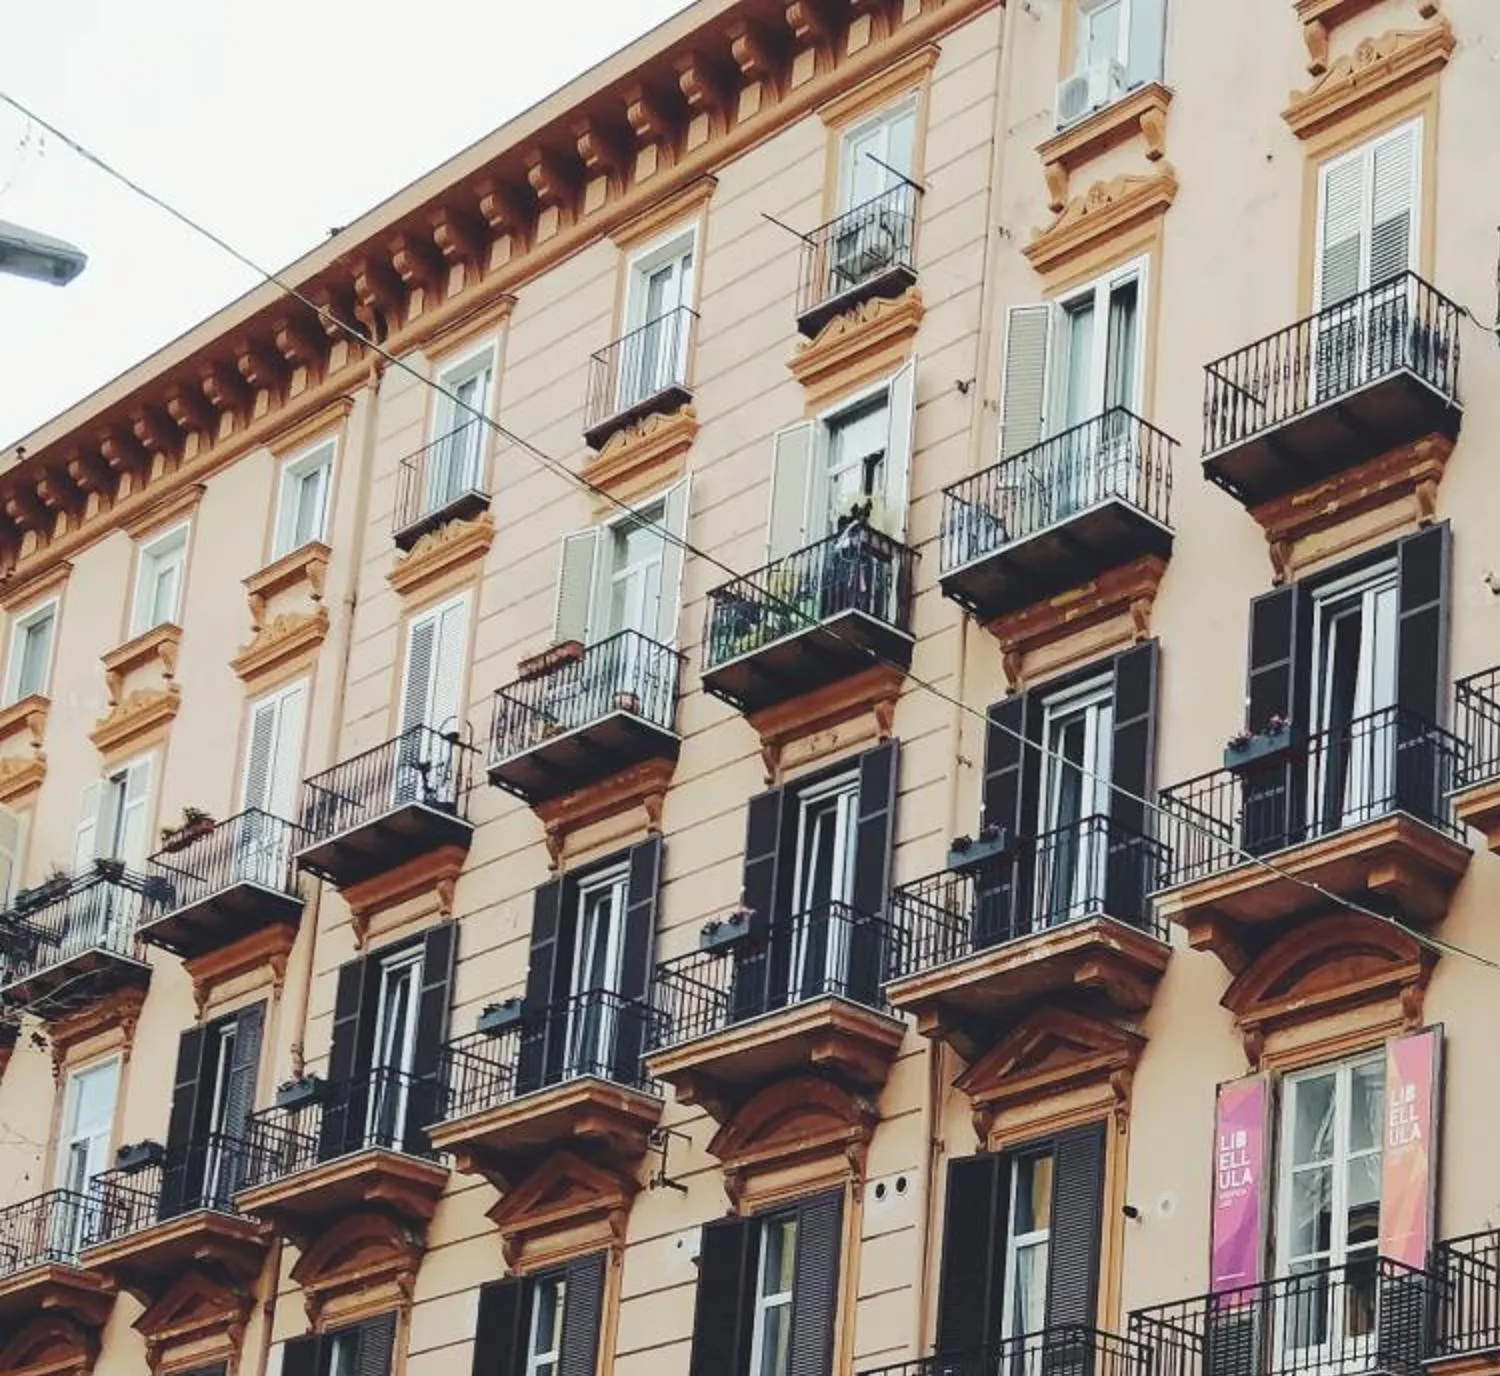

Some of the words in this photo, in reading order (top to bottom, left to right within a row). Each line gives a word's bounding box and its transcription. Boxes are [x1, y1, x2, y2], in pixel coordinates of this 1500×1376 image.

[1391, 1104, 1420, 1126] ELL
[1390, 1123, 1422, 1146] ULA
[1220, 1149, 1252, 1171] ELL
[1219, 1168, 1254, 1189] ULA
